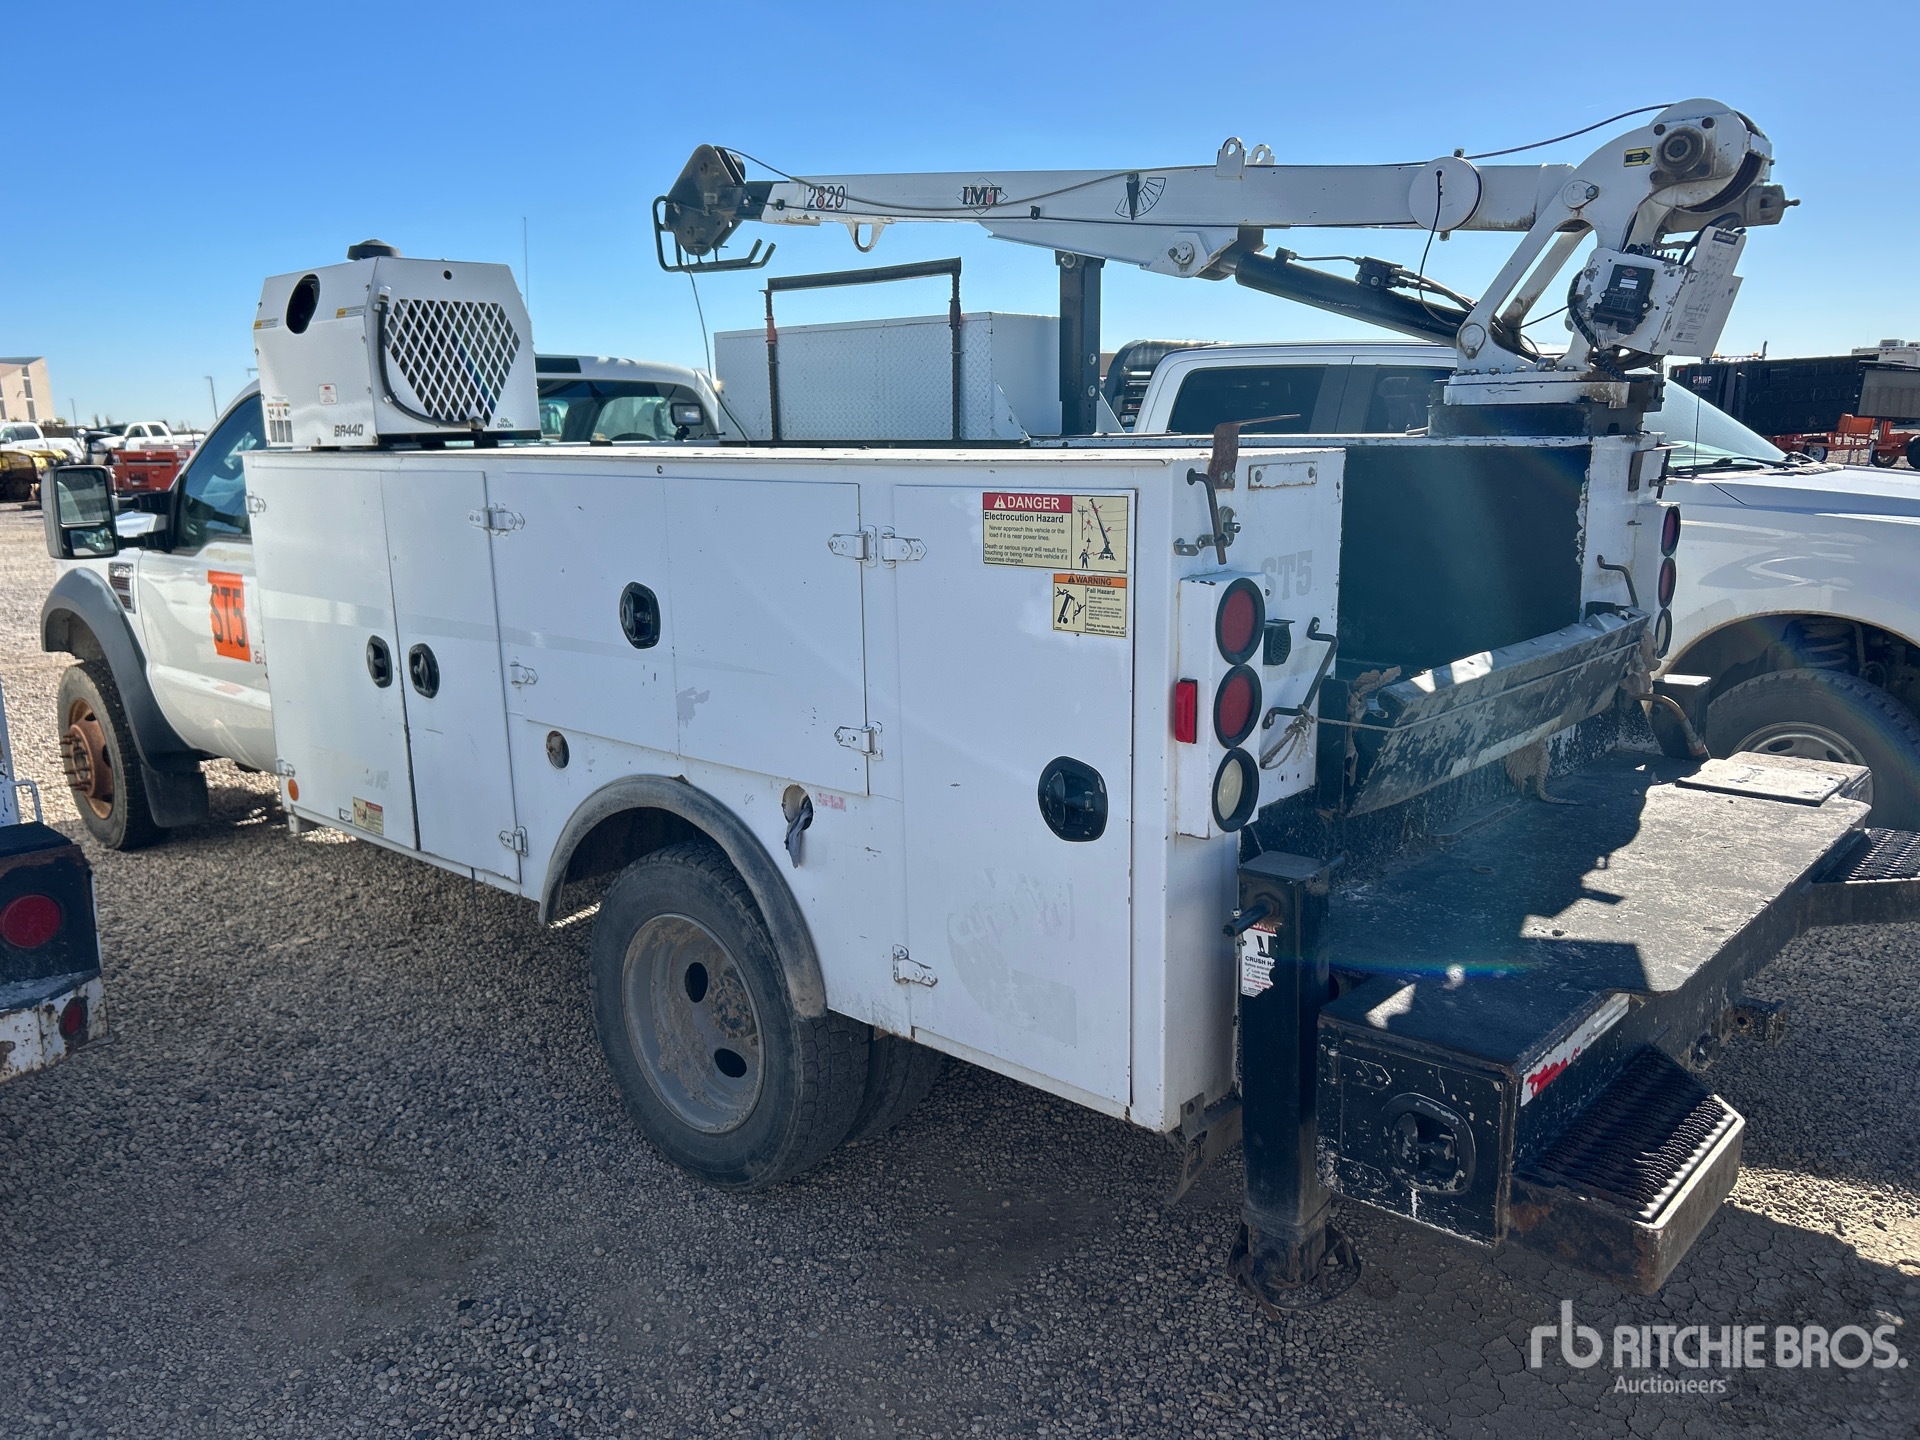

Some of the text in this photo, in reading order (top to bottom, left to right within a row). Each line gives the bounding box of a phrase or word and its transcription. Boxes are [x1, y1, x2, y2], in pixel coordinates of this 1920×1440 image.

[807, 185, 846, 209] 2820
[962, 186, 1002, 206] IMT
[1007, 496, 1060, 509] DANGER
[984, 512, 1064, 523] Electrocution Hazard
[1076, 575, 1112, 586] WARNING
[210, 584, 246, 648] ST5
[1245, 955, 1266, 965] CRUSH
